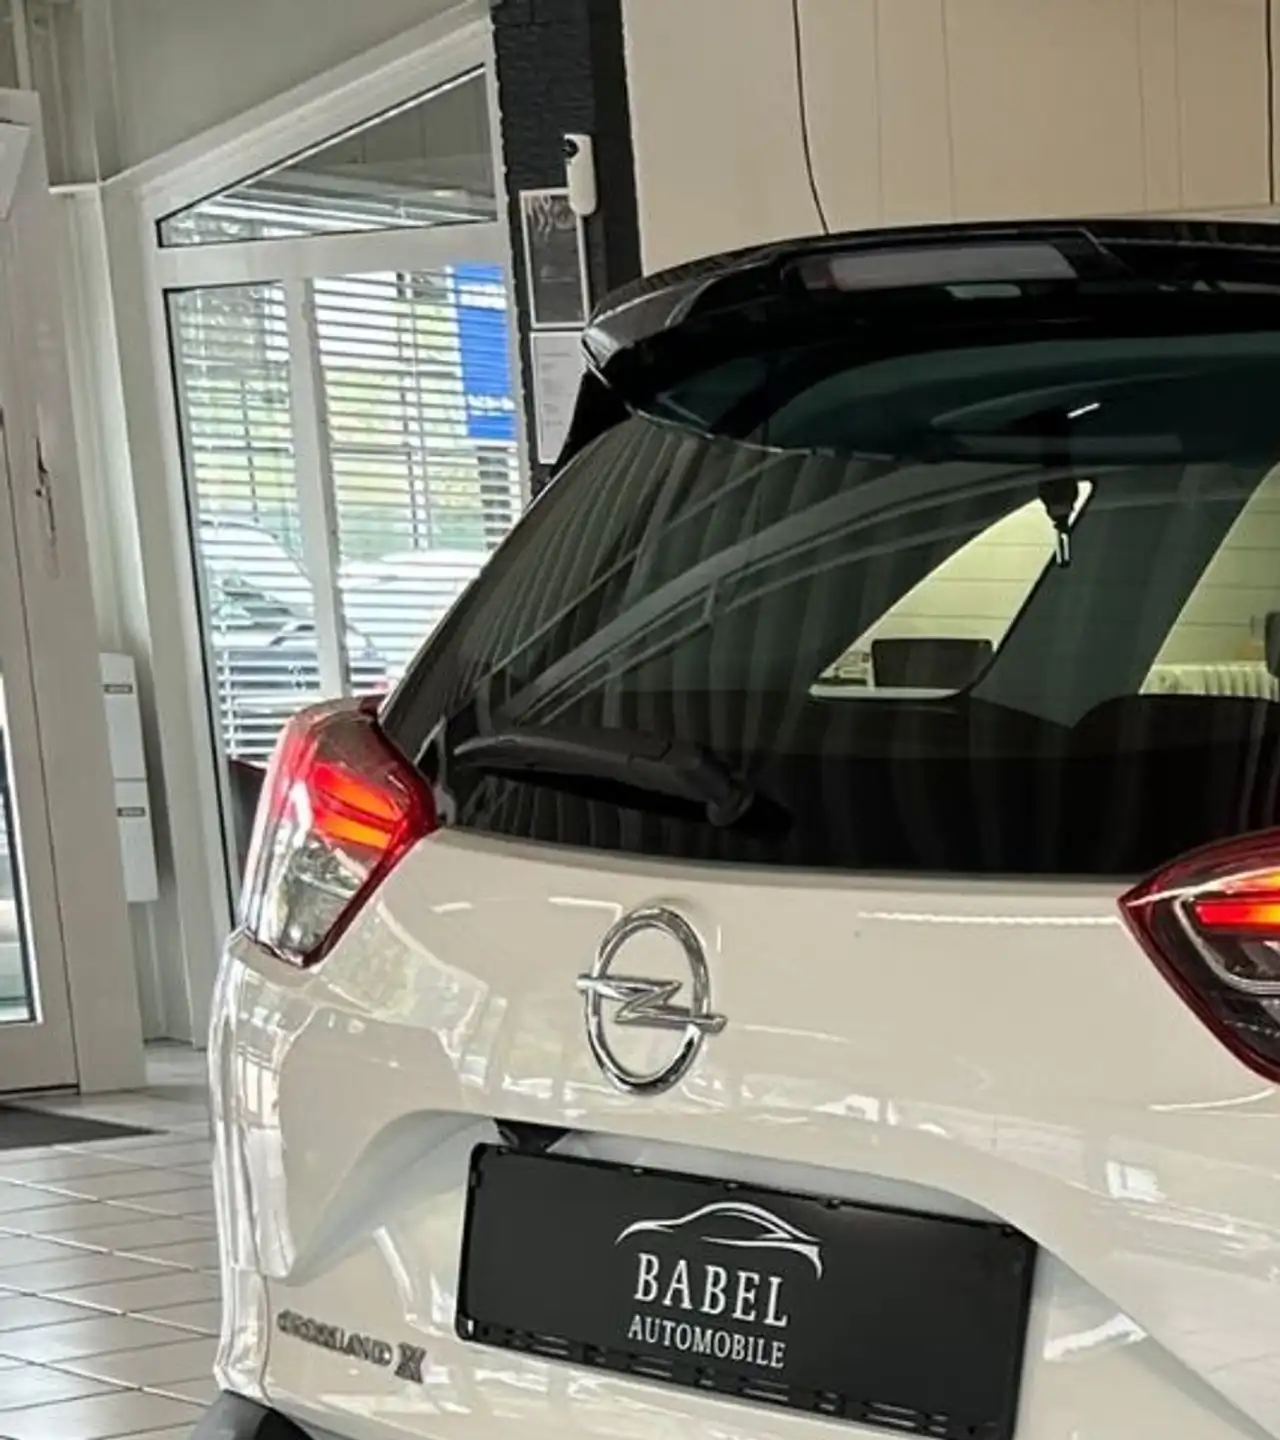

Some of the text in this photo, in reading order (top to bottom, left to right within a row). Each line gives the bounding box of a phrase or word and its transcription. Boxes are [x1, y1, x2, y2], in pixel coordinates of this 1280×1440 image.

[633, 1252, 788, 1327] BABEL
[394, 1341, 427, 1384] X
[627, 1313, 786, 1369] AUTOMOBILE
